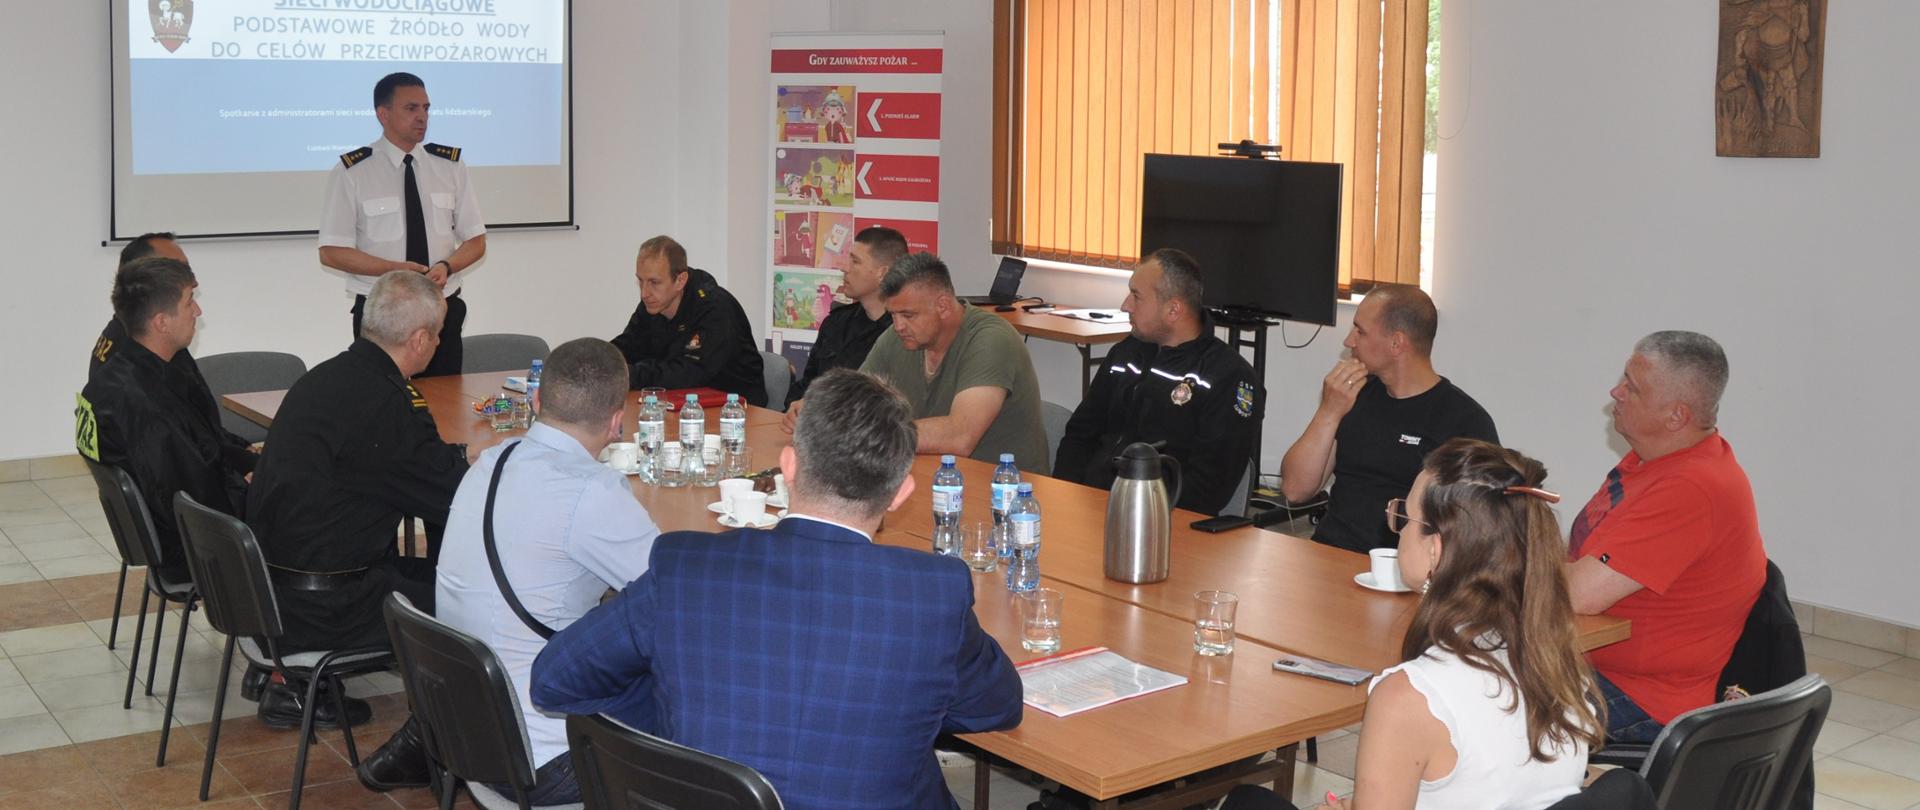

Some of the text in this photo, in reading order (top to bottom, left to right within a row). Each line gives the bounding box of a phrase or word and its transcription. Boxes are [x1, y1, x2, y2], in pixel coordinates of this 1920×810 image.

[233, 16, 531, 38] PODSTAWOWE ŹRÓDŁO WODY
[211, 40, 548, 62] DO CELÓW PRZECIWPOŻAROWYCH
[829, 55, 878, 66] ZAUWAŻYSZ
[879, 55, 908, 65] POŻAR
[219, 109, 259, 120] Spotkanie
